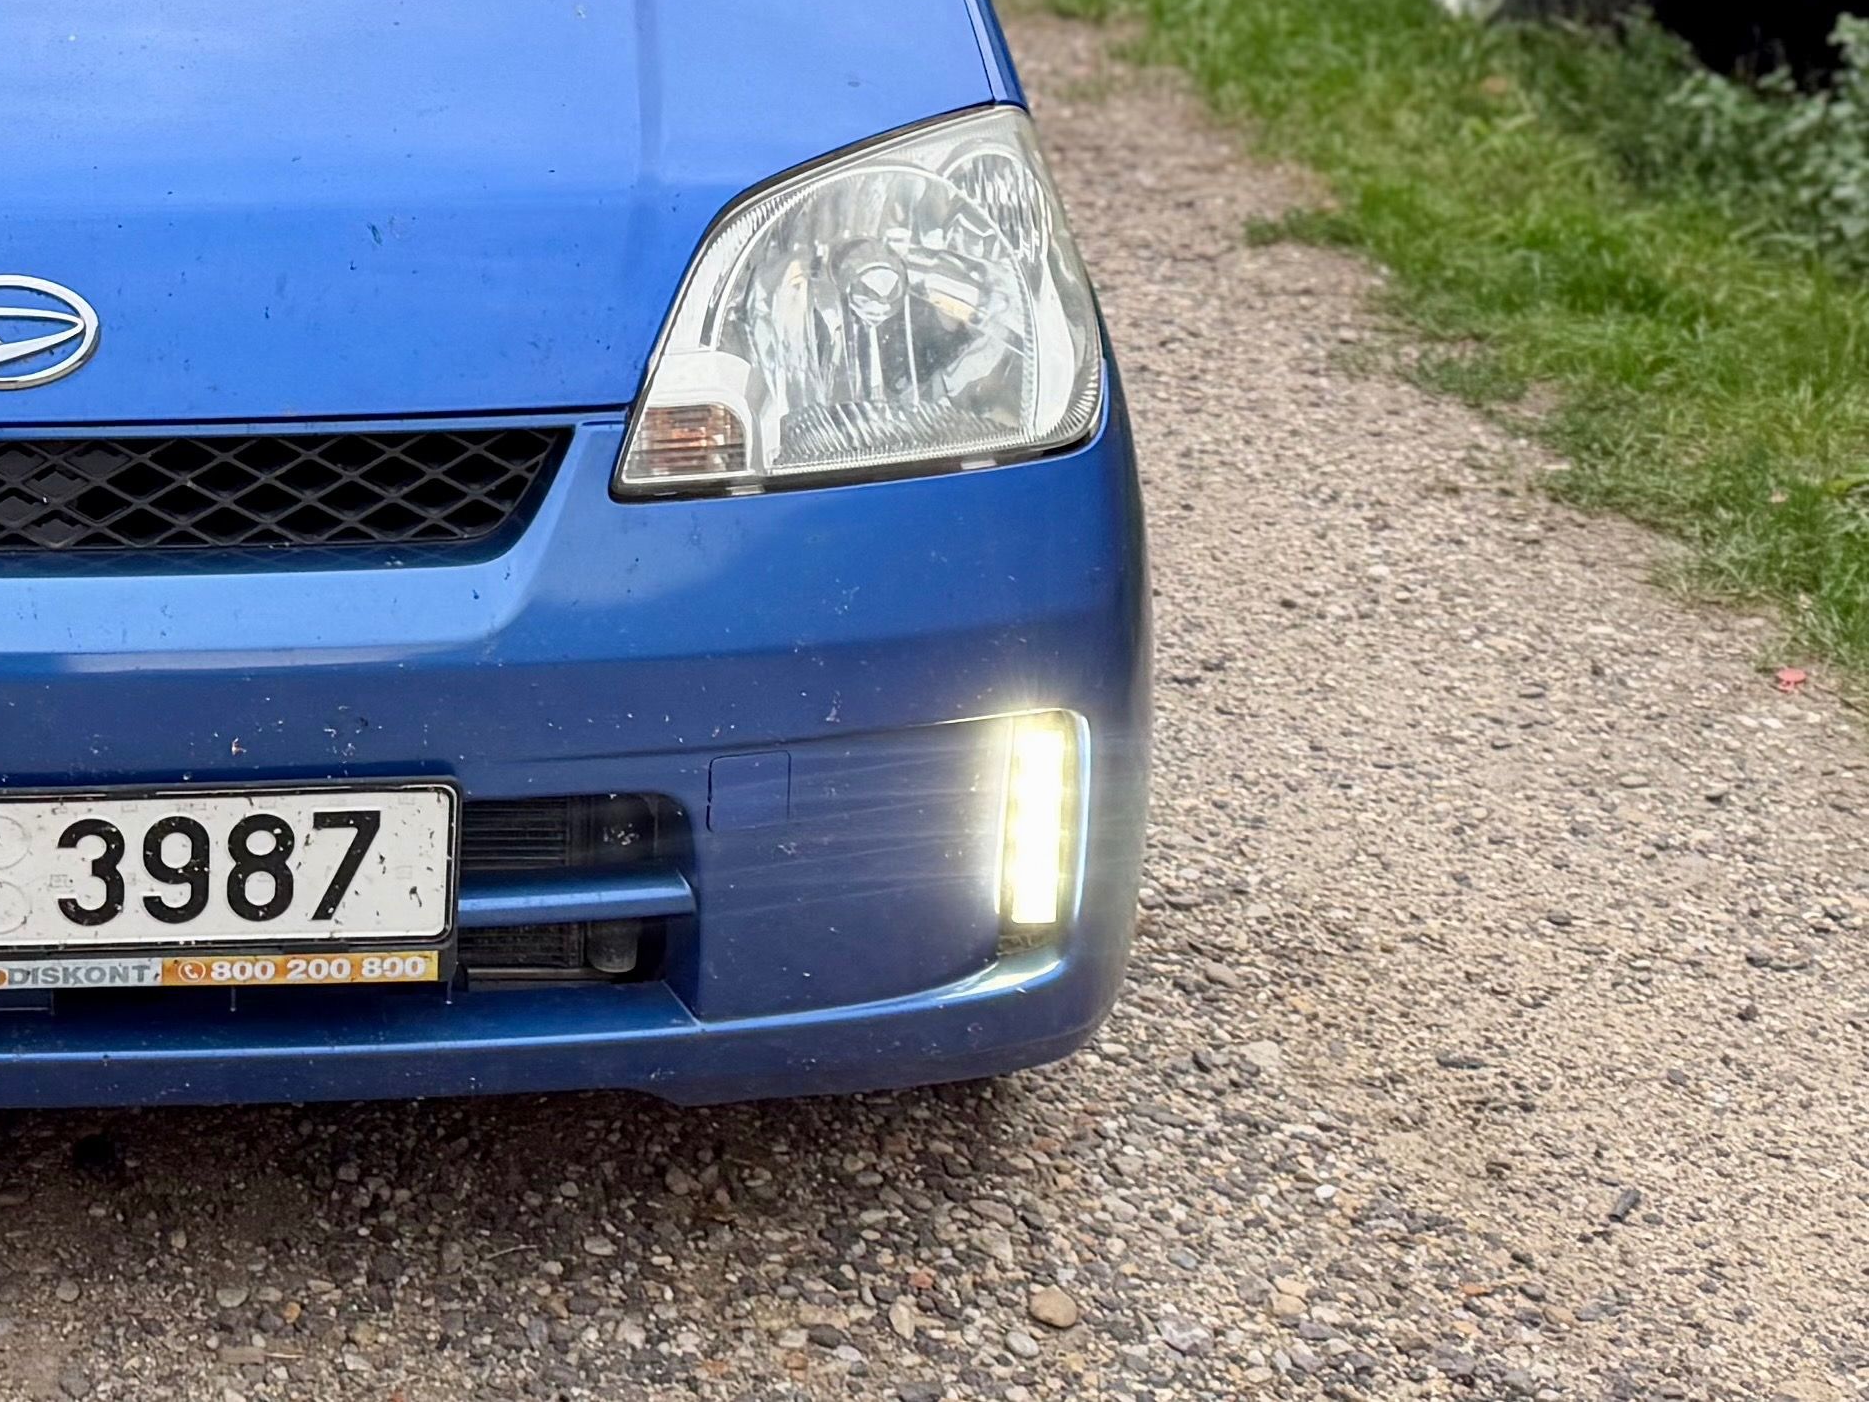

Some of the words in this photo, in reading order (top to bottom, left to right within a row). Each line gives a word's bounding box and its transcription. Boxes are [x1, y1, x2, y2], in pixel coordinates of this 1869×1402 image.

[57, 809, 382, 927] 3987
[210, 960, 276, 981] 800
[286, 958, 351, 980] 200
[361, 956, 427, 978] 800
